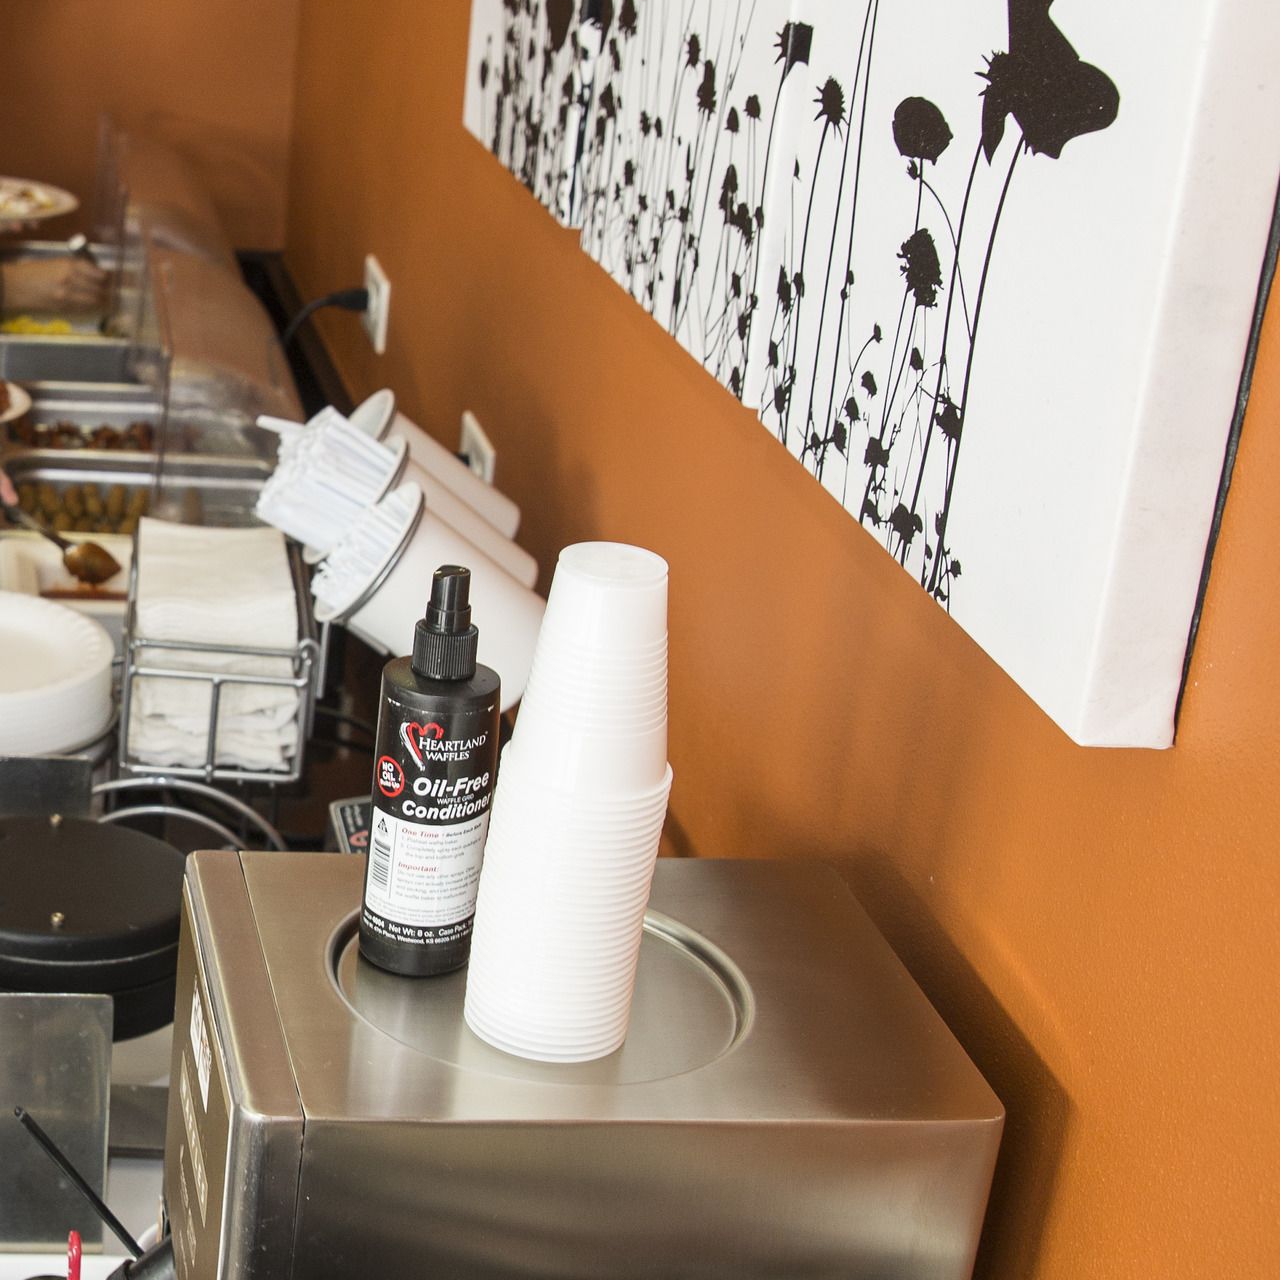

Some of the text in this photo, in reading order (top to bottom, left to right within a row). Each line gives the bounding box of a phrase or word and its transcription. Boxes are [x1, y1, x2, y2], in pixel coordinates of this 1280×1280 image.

[419, 734, 486, 752] HEARTLAND
[425, 750, 470, 762] WAFFLES
[382, 761, 394, 772] NO
[382, 771, 396, 781] OIL
[413, 772, 489, 797] Oil-Free
[402, 792, 491, 820] Conditioner
[436, 796, 461, 805] WAFFLE
[398, 862, 439, 872] Important:
[388, 923, 401, 934] Net
